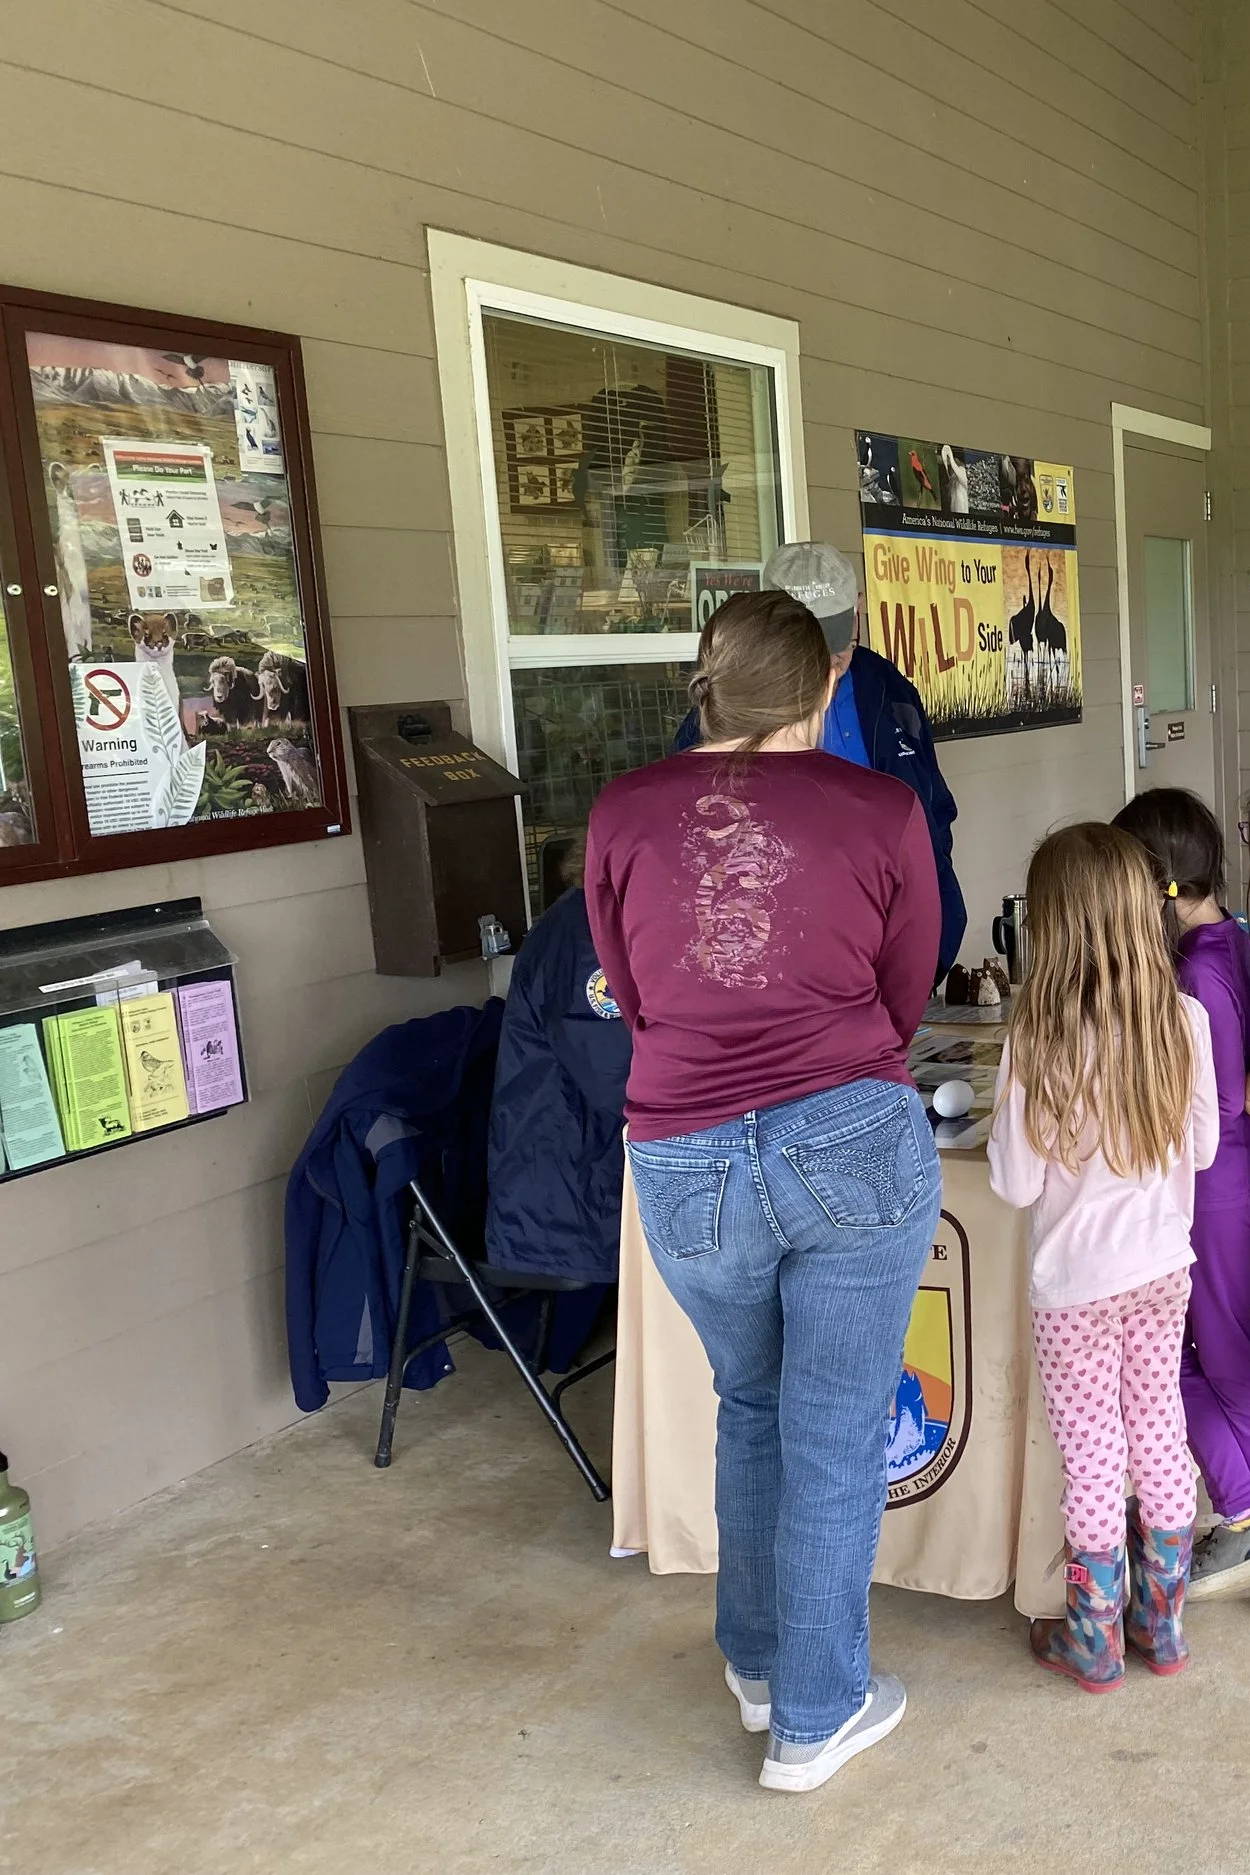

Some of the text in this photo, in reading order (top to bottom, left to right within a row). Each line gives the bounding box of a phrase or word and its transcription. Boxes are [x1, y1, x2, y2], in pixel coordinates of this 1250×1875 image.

[132, 465, 154, 474] Please
[154, 466, 164, 474] Do
[164, 467, 179, 475] Your
[902, 513, 931, 526] America's
[932, 516, 955, 528] National
[977, 521, 999, 534] Refuges
[873, 543, 997, 594] Give Wing to Your
[704, 573, 755, 587] Yes We're
[880, 597, 1003, 684] WILD Side
[82, 738, 137, 752] Warning
[110, 758, 148, 768] Prohibited
[400, 751, 488, 768] FEEDBACK
[443, 768, 482, 781] BOX
[888, 1437, 957, 1499] HE INTERIOR
